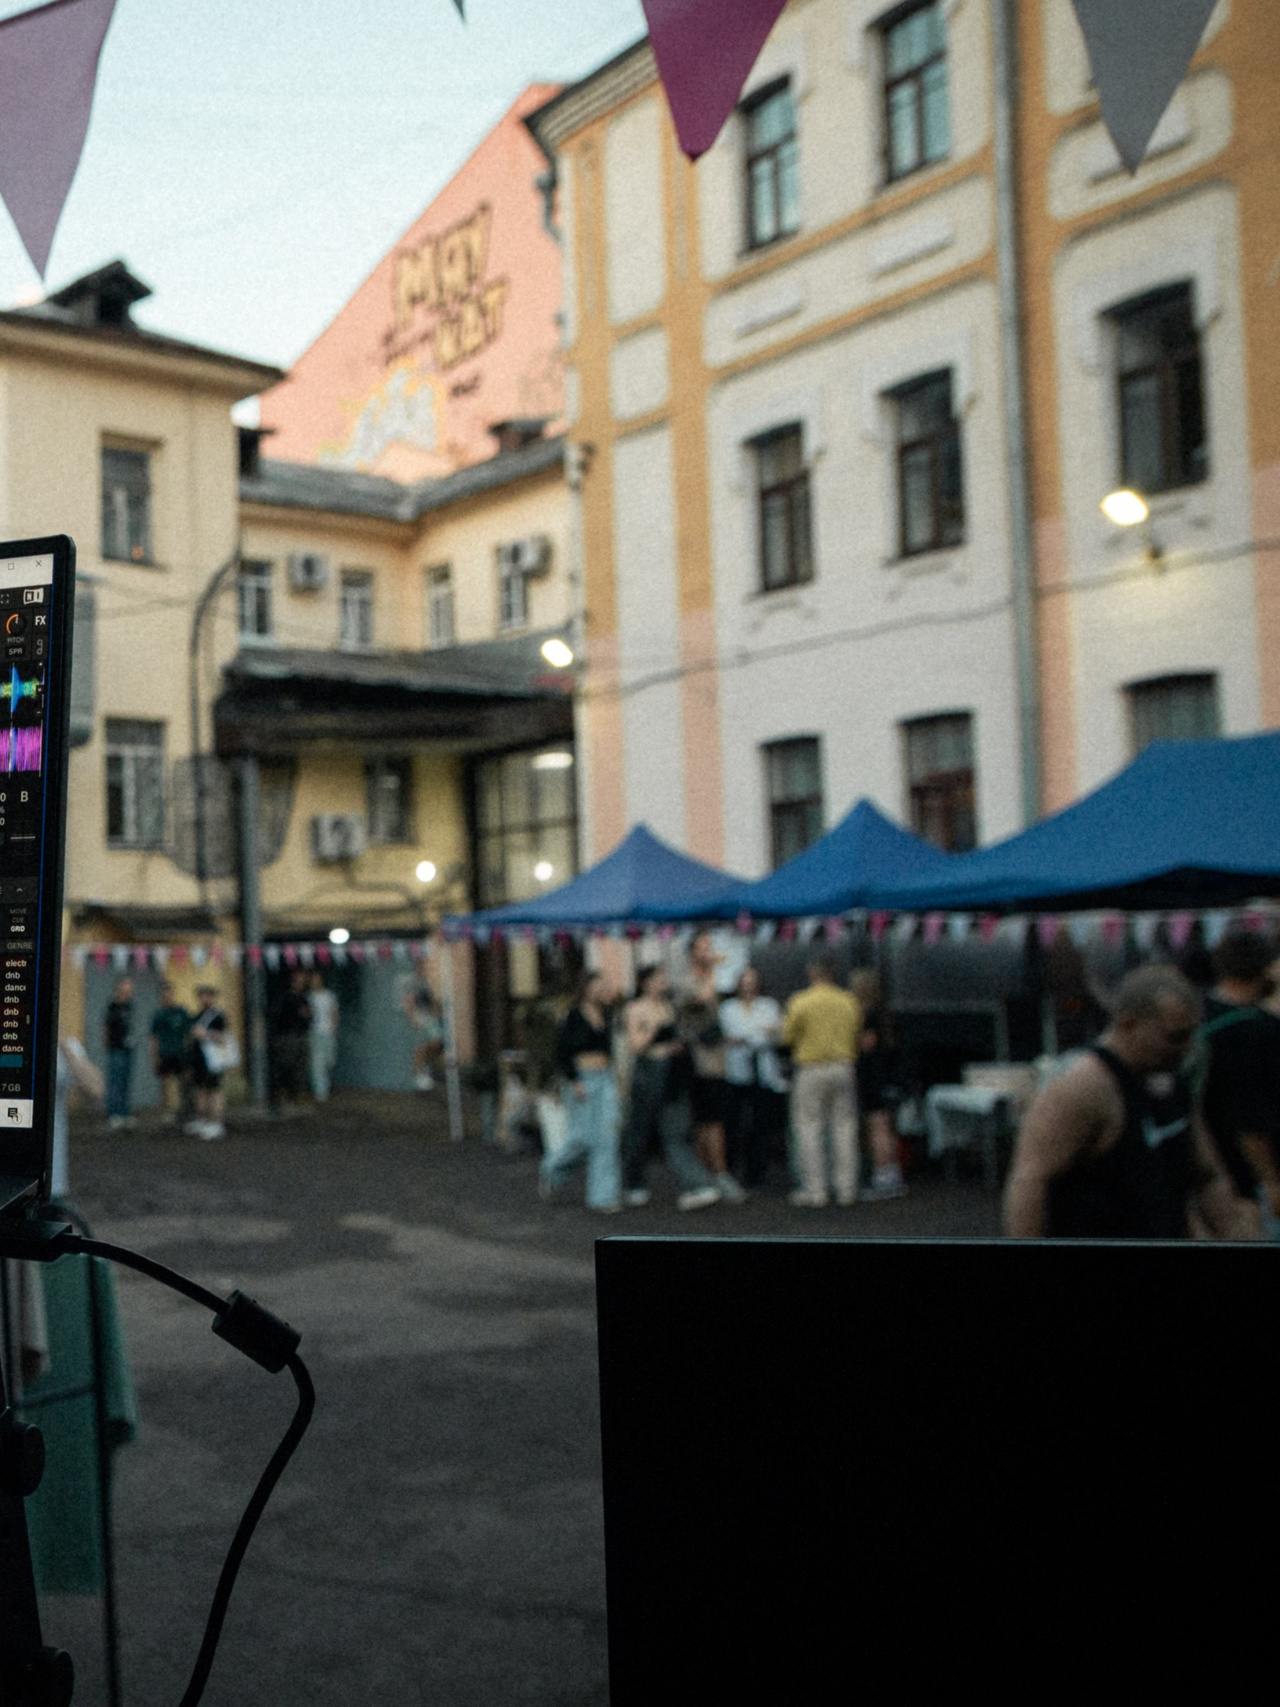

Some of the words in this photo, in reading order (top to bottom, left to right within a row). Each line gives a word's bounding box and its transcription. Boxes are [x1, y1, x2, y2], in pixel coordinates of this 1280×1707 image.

[34, 615, 47, 626] FX
[8, 647, 23, 656] SPR
[20, 790, 29, 802] B
[4, 996, 19, 1004] dnb
[8, 1084, 21, 1092] GB
